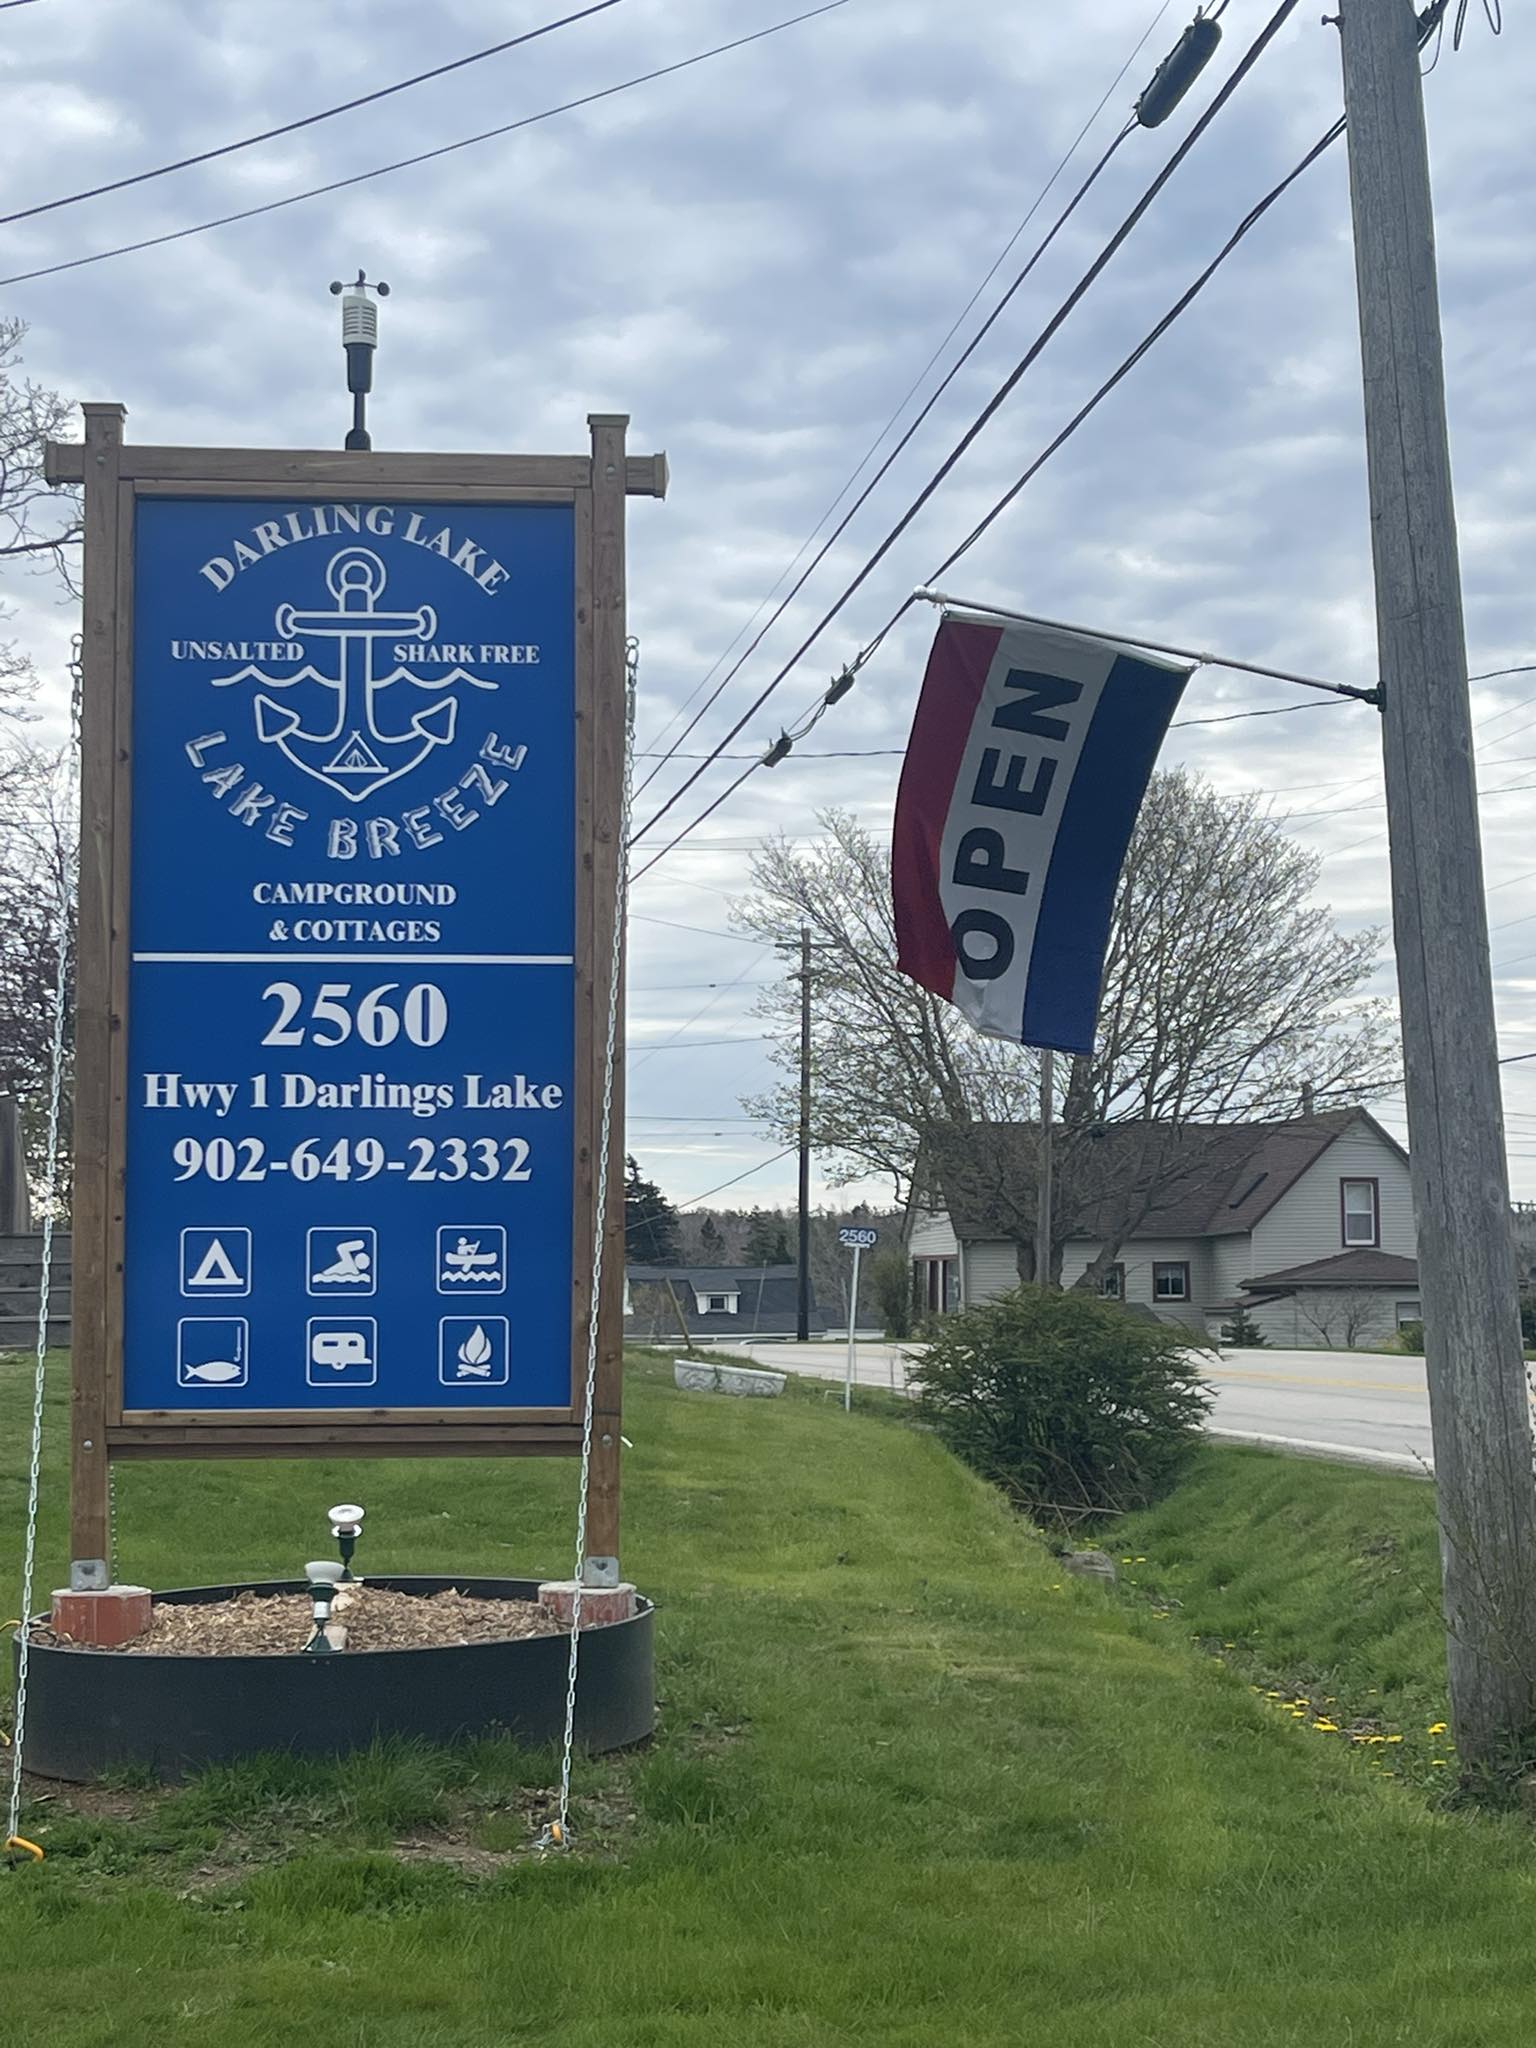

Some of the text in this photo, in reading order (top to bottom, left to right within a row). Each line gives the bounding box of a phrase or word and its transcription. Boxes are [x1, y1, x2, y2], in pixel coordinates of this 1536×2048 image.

[200, 504, 511, 597] DARLING LAKE
[170, 640, 305, 661] UNSALTED
[393, 643, 540, 664] SHARK FREE
[184, 731, 528, 860] LAKE BREEZE
[951, 668, 1085, 981] OPEN
[252, 882, 456, 906] CAMPGROUND
[268, 920, 441, 942] & COTTAGES
[261, 981, 448, 1048] 2560
[143, 1073, 563, 1117] Hwy 1 Darlings Lake
[172, 1137, 532, 1182] 902-649-2332
[839, 1228, 877, 1244] 2560
